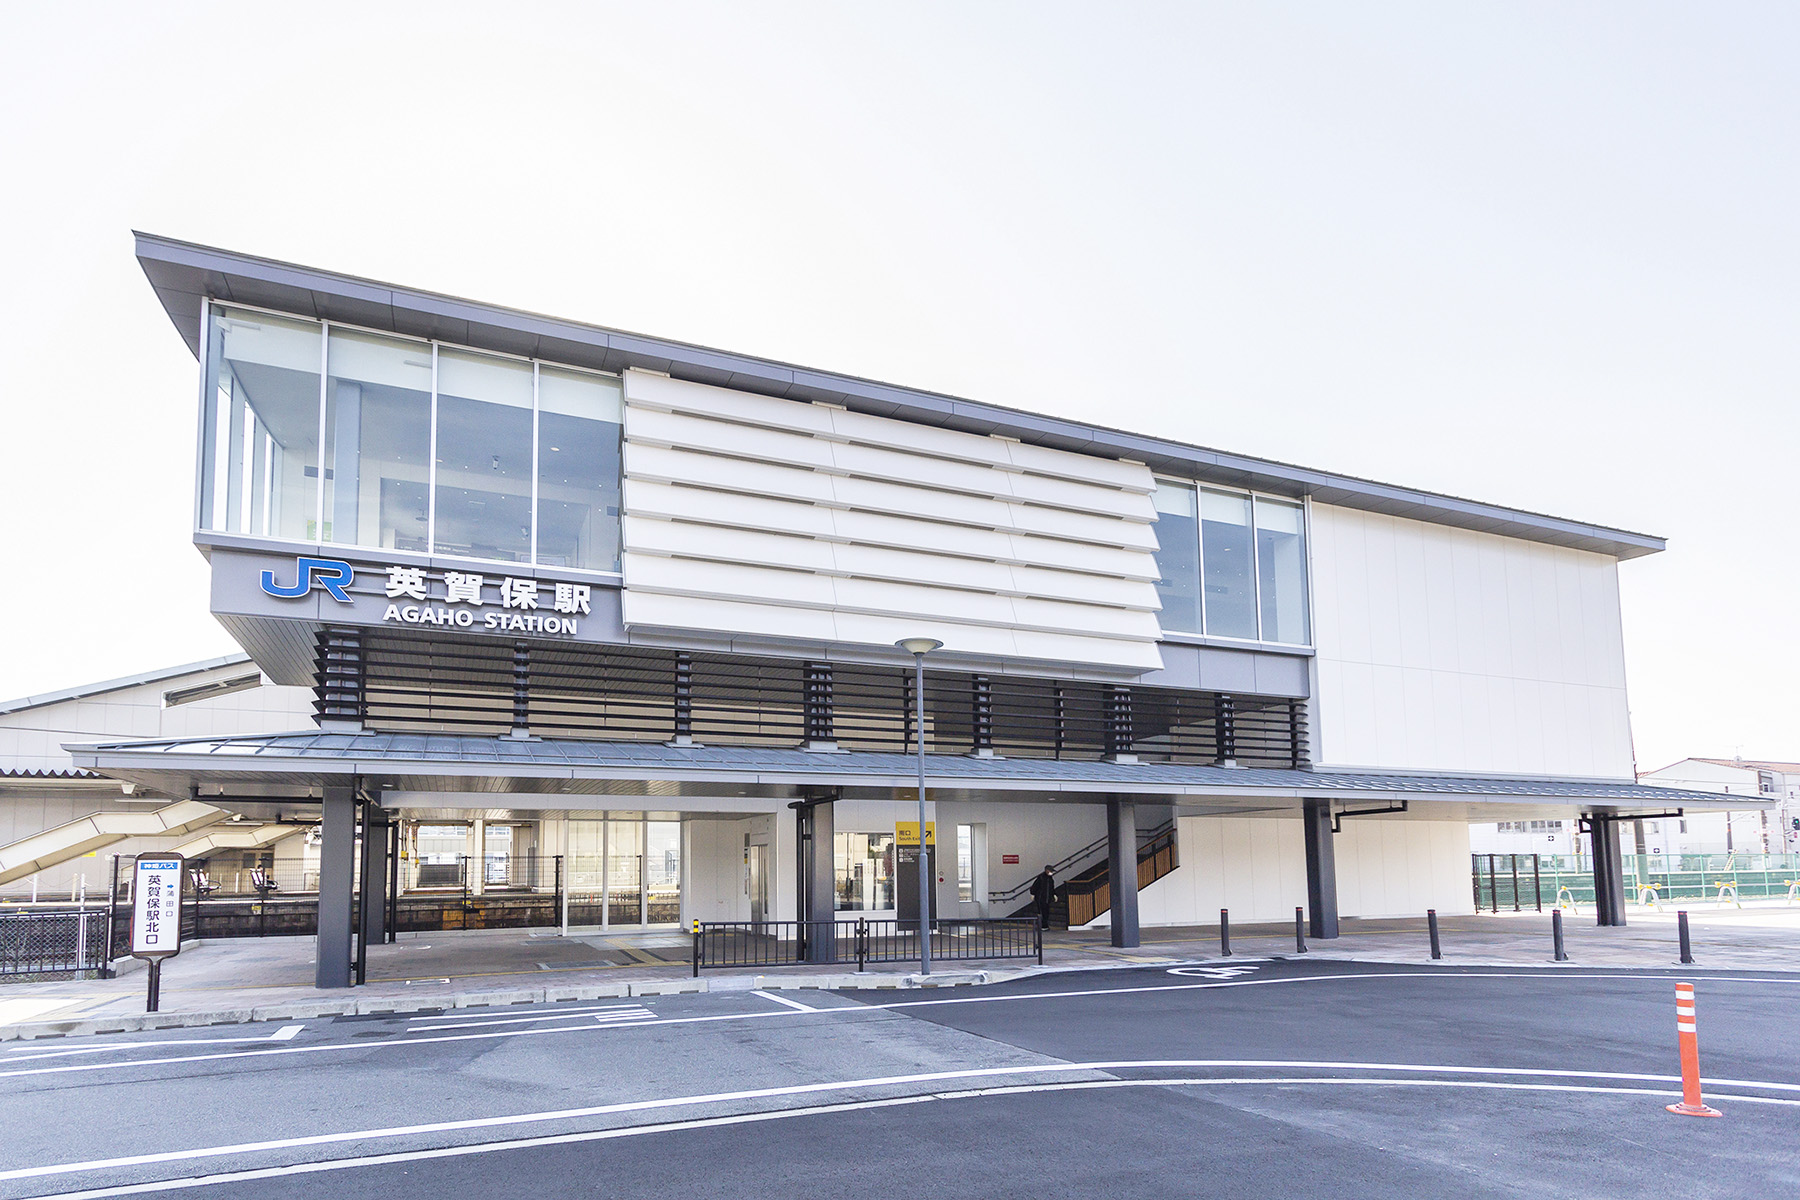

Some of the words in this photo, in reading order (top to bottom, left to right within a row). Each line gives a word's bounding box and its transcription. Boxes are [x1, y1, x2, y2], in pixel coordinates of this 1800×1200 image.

[259, 556, 355, 604] JR
[384, 565, 593, 616] 英賀保駅
[382, 603, 474, 628] AGAHO
[484, 611, 578, 636] STATION
[145, 874, 161, 945] 英賀保駅北口
